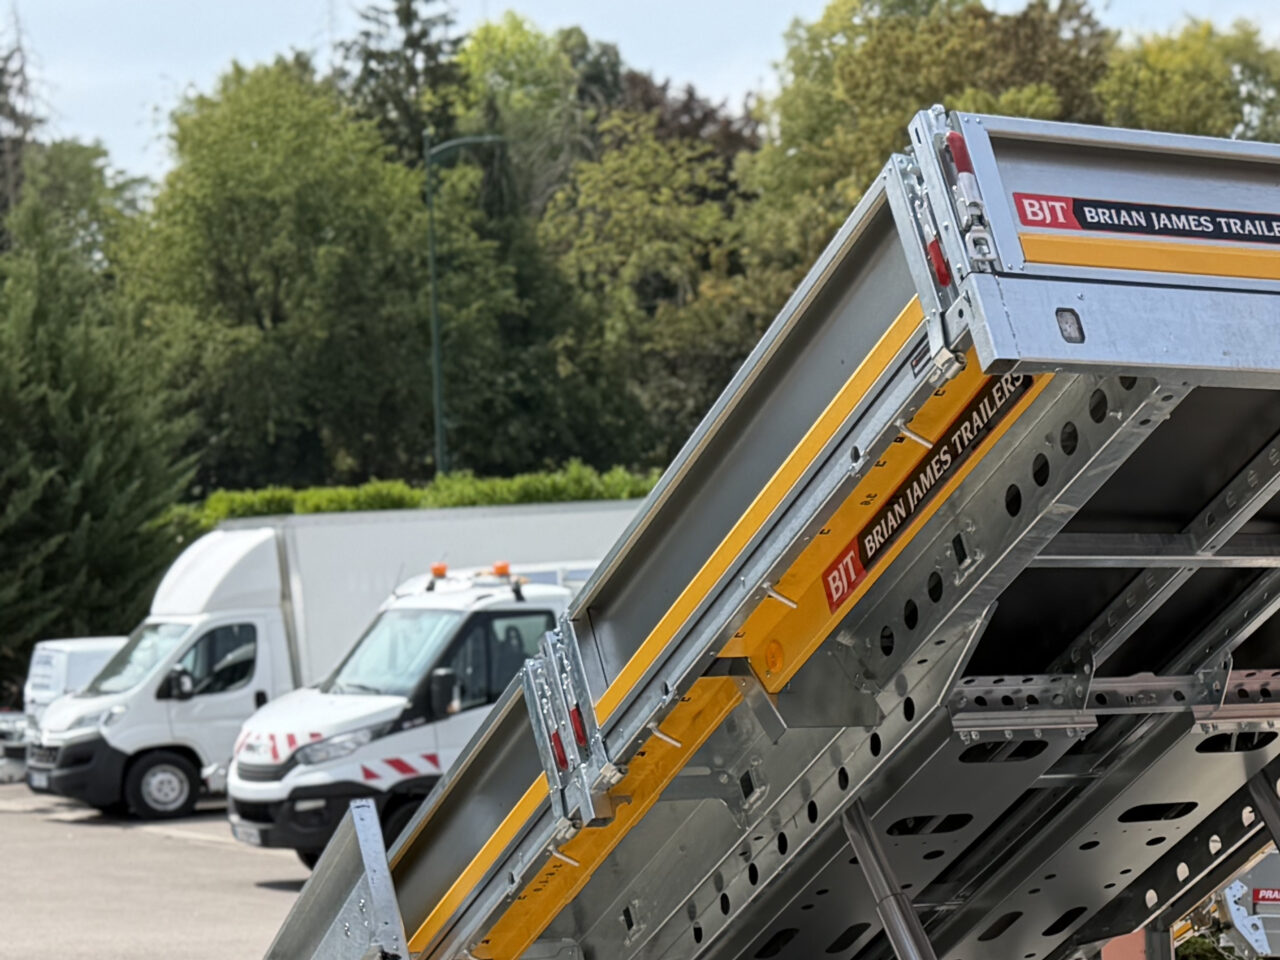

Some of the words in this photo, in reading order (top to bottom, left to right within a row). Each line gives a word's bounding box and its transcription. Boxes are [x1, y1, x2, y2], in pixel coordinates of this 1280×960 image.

[1021, 198, 1067, 224] BJT
[1083, 206, 1147, 227] BRIAN
[1150, 211, 1212, 232] JAMES
[827, 551, 857, 602] BJT
[863, 503, 907, 559] BRIAN
[907, 448, 952, 513] JAMES
[951, 373, 1024, 454] TRAILERS
